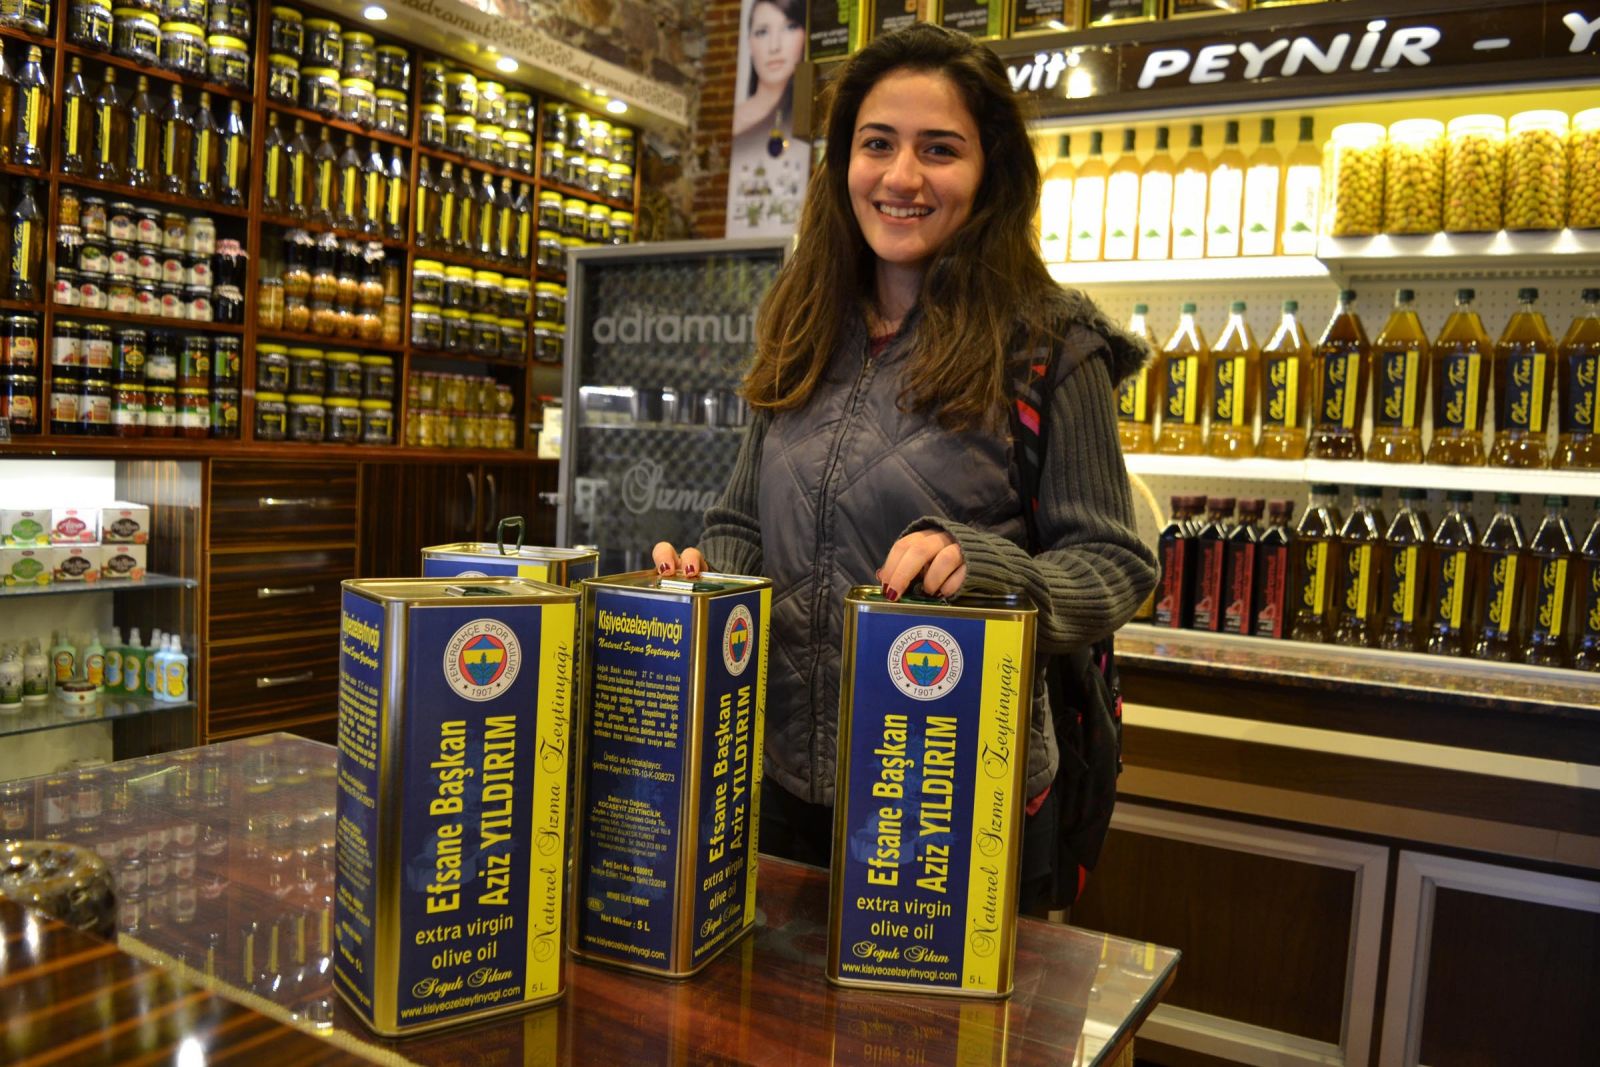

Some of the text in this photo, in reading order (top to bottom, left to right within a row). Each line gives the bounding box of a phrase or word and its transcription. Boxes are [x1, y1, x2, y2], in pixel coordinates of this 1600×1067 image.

[484, 623, 509, 641] SPOR
[892, 629, 923, 682] FENERBAHÇE
[927, 630, 950, 647] SPOR
[471, 687, 493, 697] 1907
[913, 687, 934, 697] 1907
[732, 685, 751, 803] YILDIRIM
[709, 692, 733, 863] Efsane Başkan
[426, 720, 474, 914] Efsane Başkan
[478, 715, 517, 906] Aziz YILDIRIM
[867, 713, 914, 886] Efsane Başkan
[916, 716, 958, 893] Aziz YILDIRIM
[730, 803, 745, 850] Aziz
[703, 870, 724, 891] extra
[709, 890, 727, 910] olive
[856, 896, 951, 919] extra virgin
[969, 865, 999, 958] Naturel
[415, 914, 514, 945] extra virgin
[871, 920, 934, 940] olive oil
[431, 941, 497, 970] olive oil
